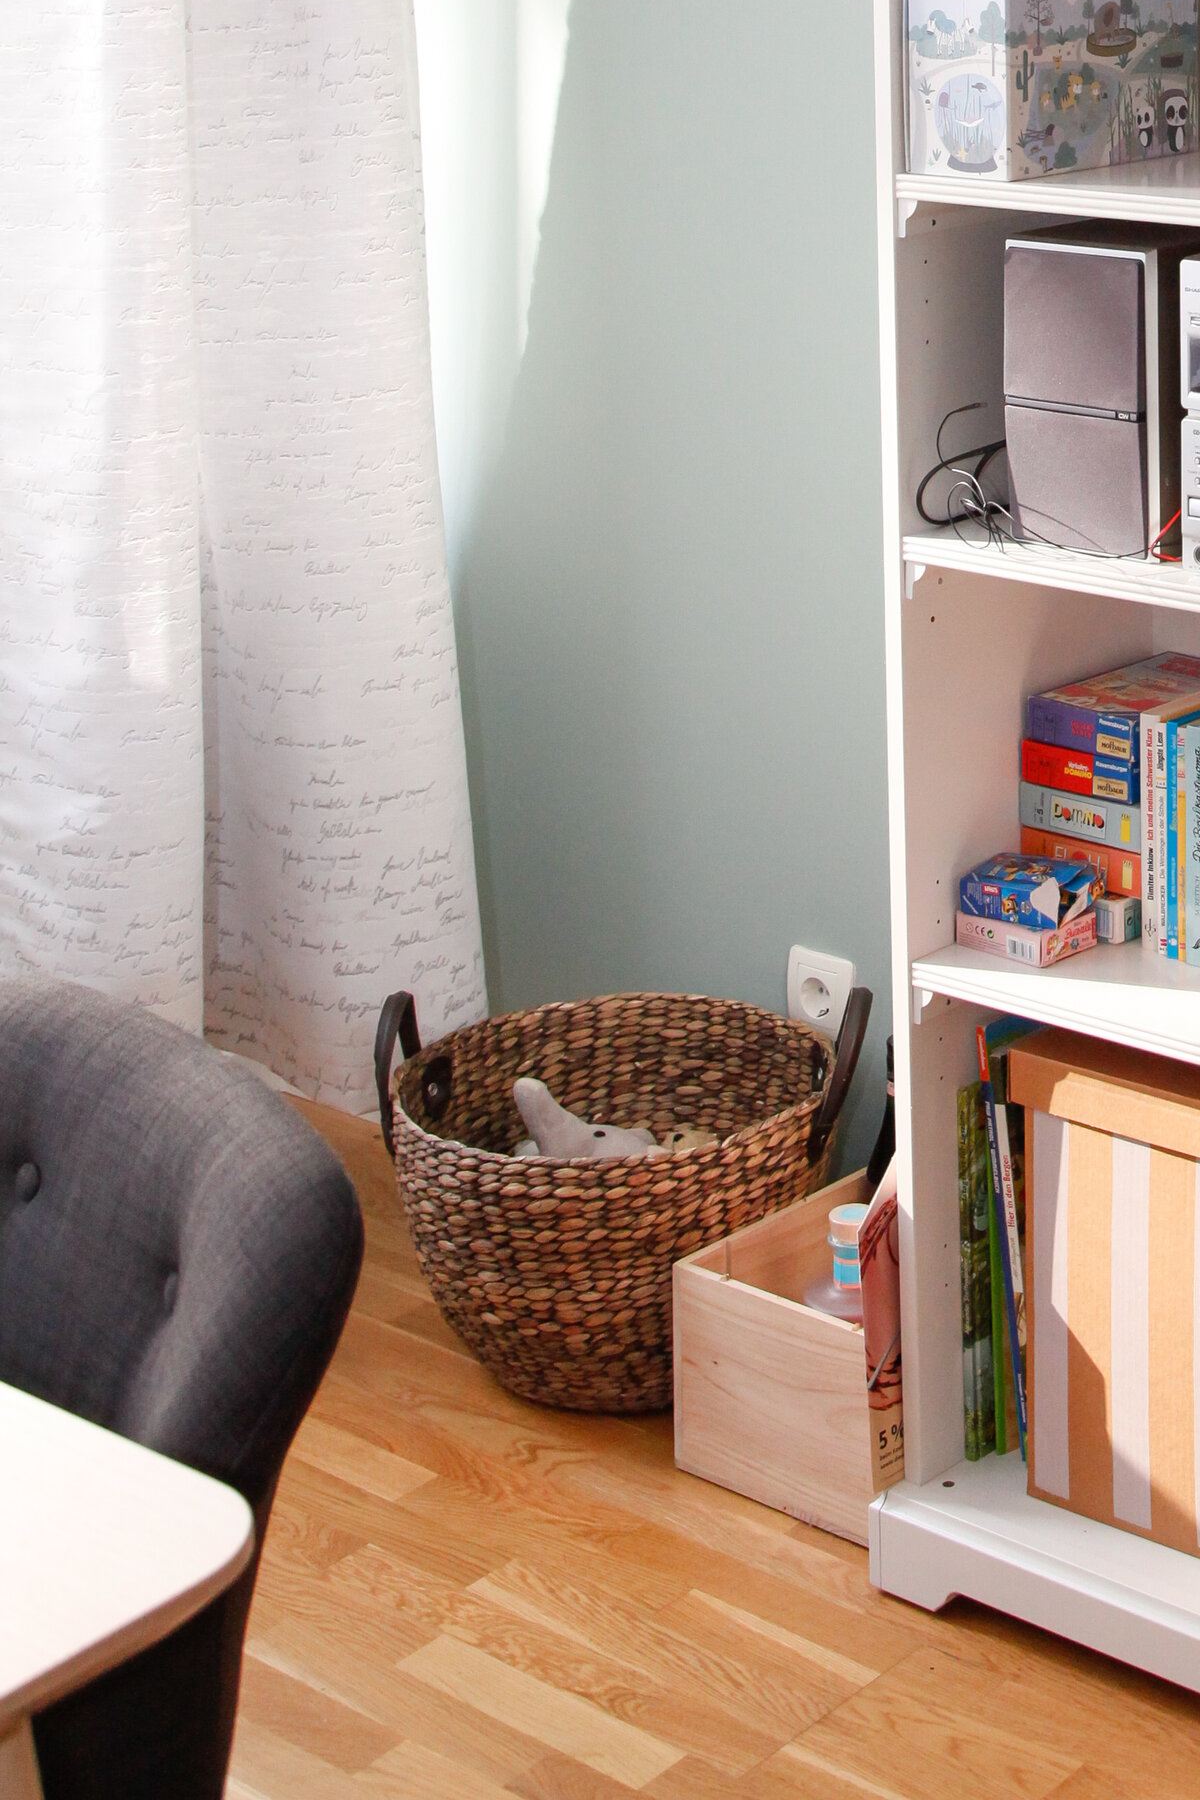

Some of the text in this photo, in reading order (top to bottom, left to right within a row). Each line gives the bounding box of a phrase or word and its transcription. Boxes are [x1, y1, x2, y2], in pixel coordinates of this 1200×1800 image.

[1145, 728, 1153, 748] Klara
[1064, 767, 1093, 779] DOMINO
[1146, 788, 1154, 813] meine
[1146, 814, 1154, 828] und
[1146, 828, 1154, 841] Ich
[1146, 873, 1154, 901] Dimiter
[1002, 1155, 1015, 1228] Hier in den Bergen
[879, 1429, 888, 1449] 5
